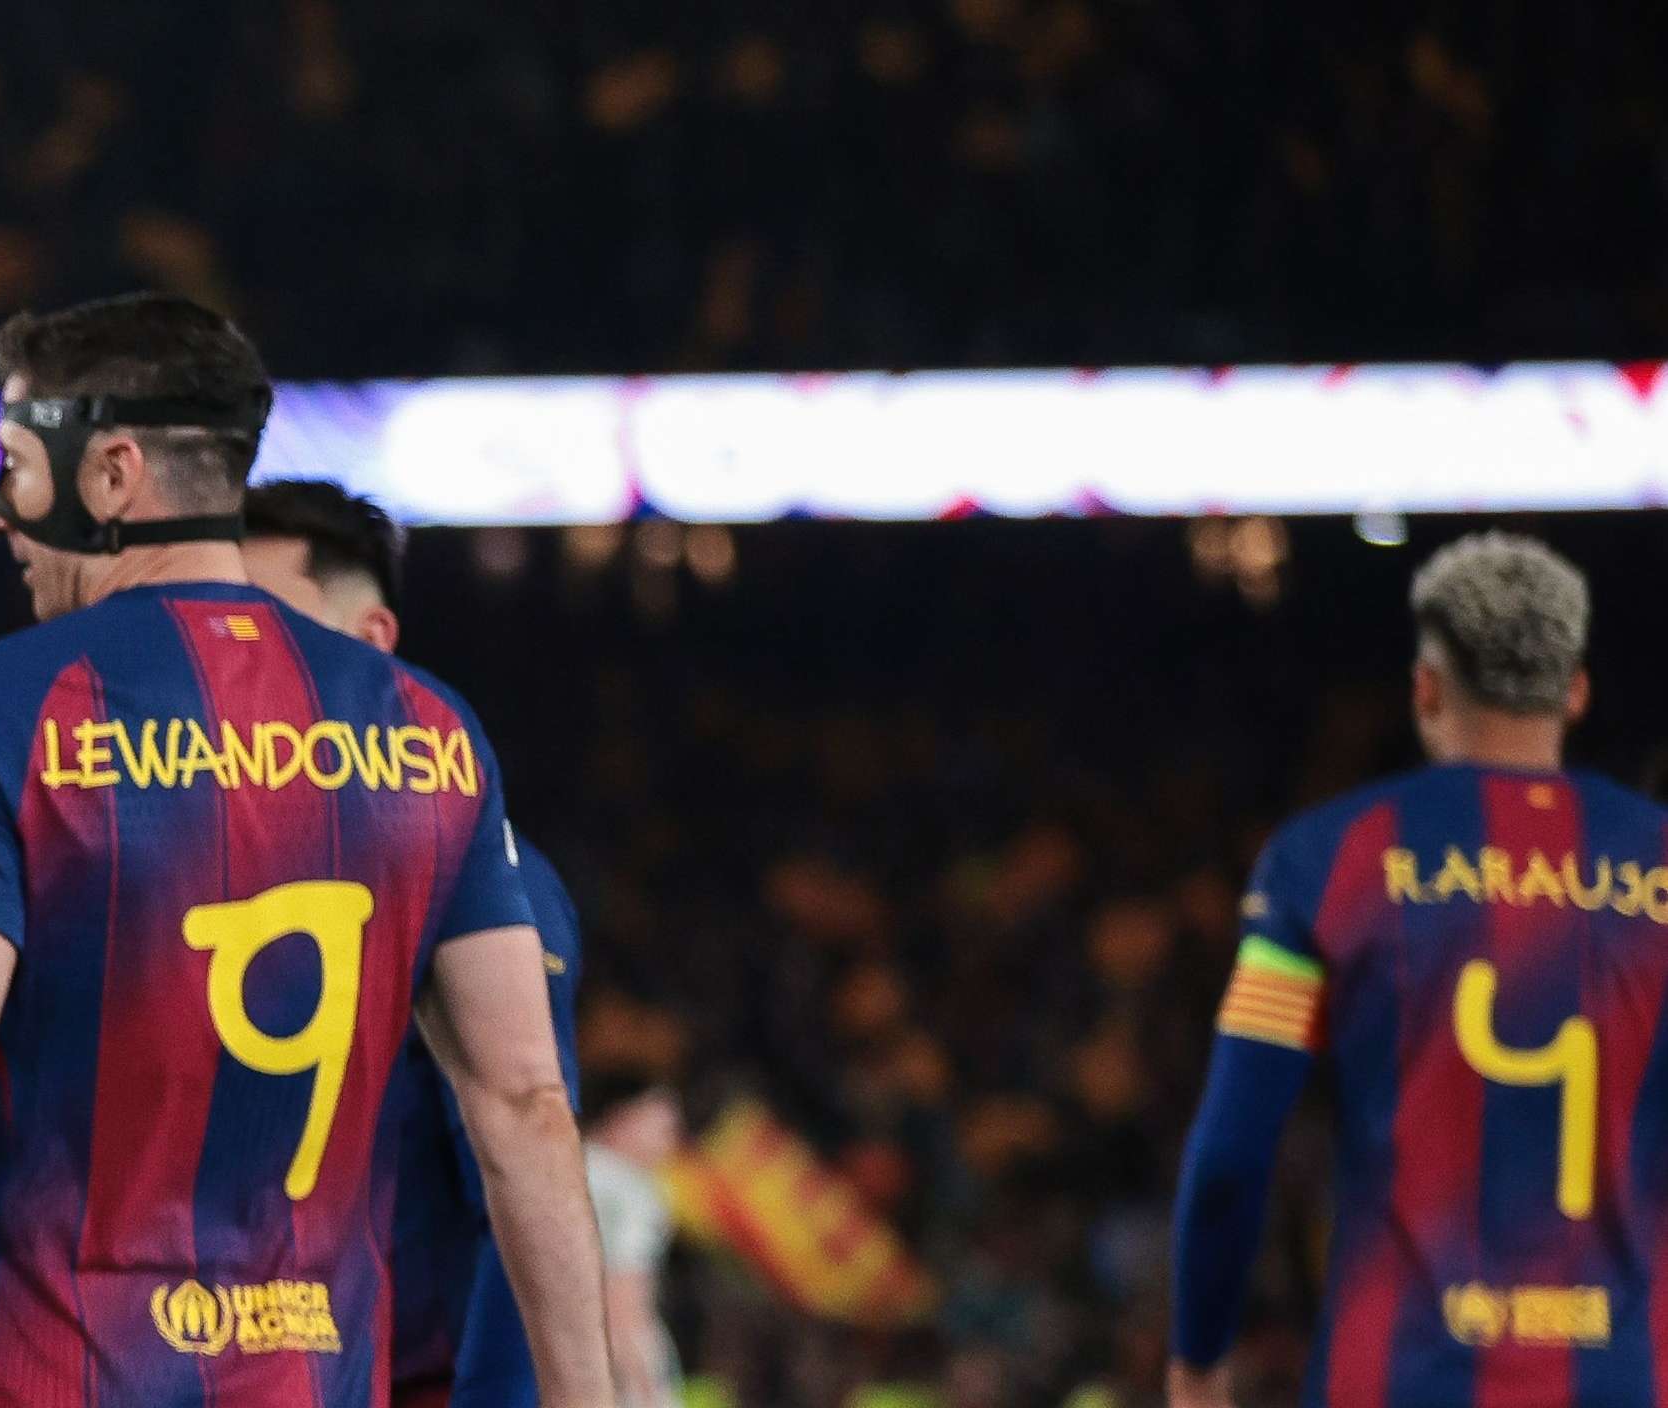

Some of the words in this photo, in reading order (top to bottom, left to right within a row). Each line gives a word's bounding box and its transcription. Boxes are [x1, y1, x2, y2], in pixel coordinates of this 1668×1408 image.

[42, 719, 480, 798] LEWANDOWSKI
[182, 879, 375, 1201] 9
[1452, 957, 1599, 1221] 4
